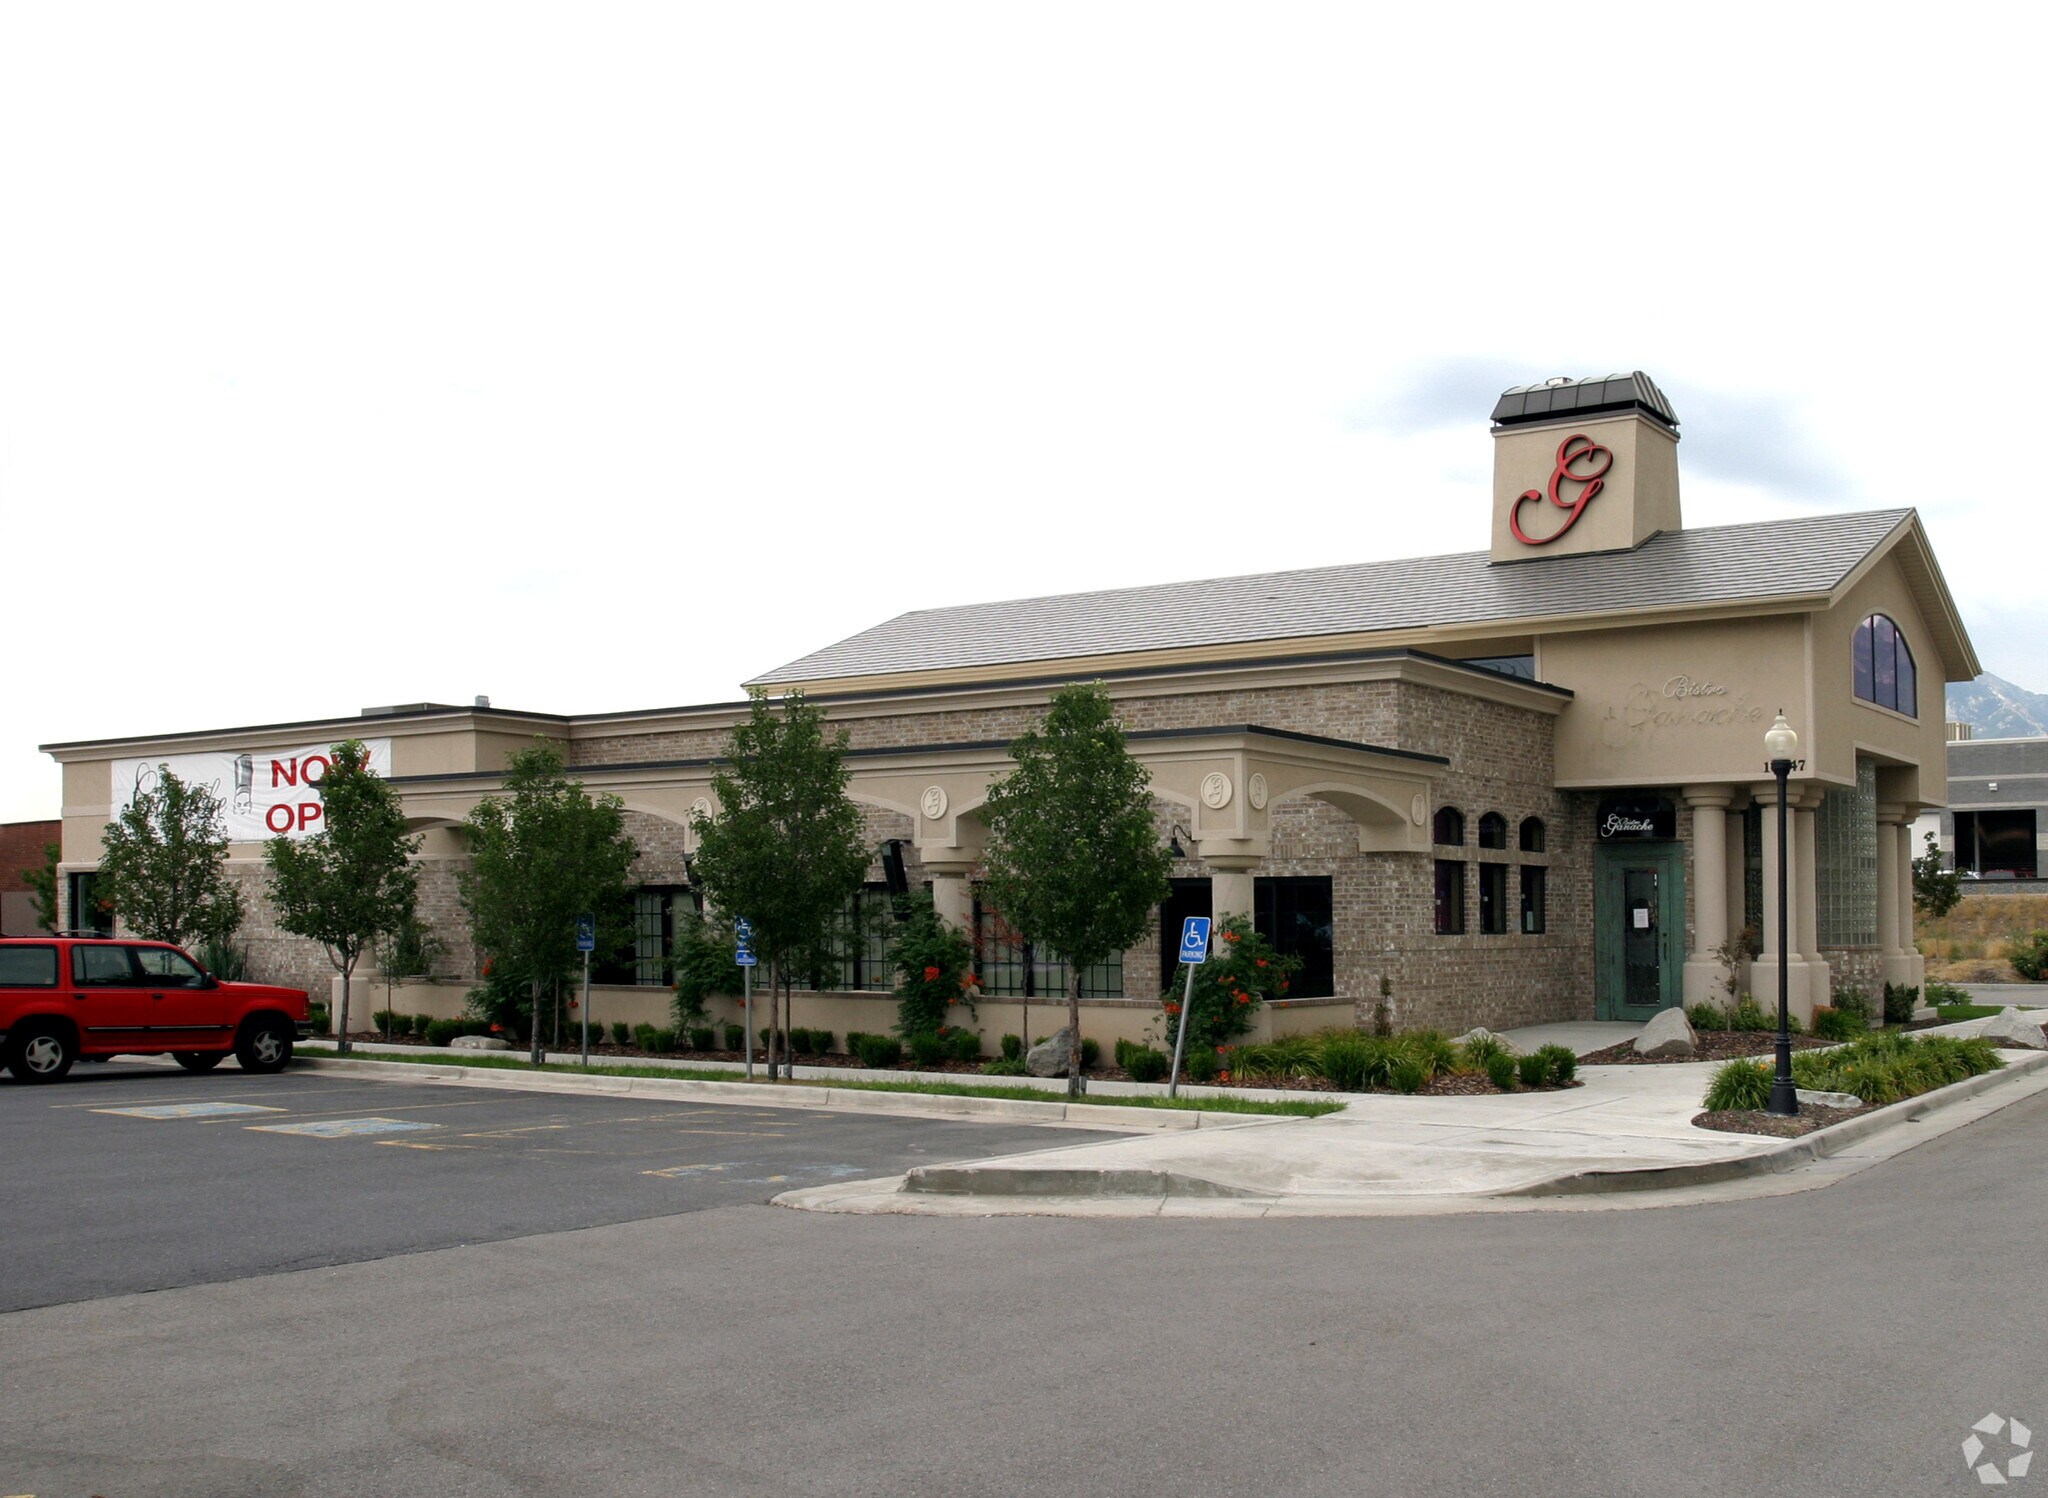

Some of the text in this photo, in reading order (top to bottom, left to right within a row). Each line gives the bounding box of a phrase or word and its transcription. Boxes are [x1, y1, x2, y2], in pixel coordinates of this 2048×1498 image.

[1510, 434, 1613, 545] G
[1663, 674, 1728, 699] Bistro
[1763, 759, 1805, 773] 147
[265, 802, 328, 833] OP
[1600, 813, 1654, 838] Ganache
